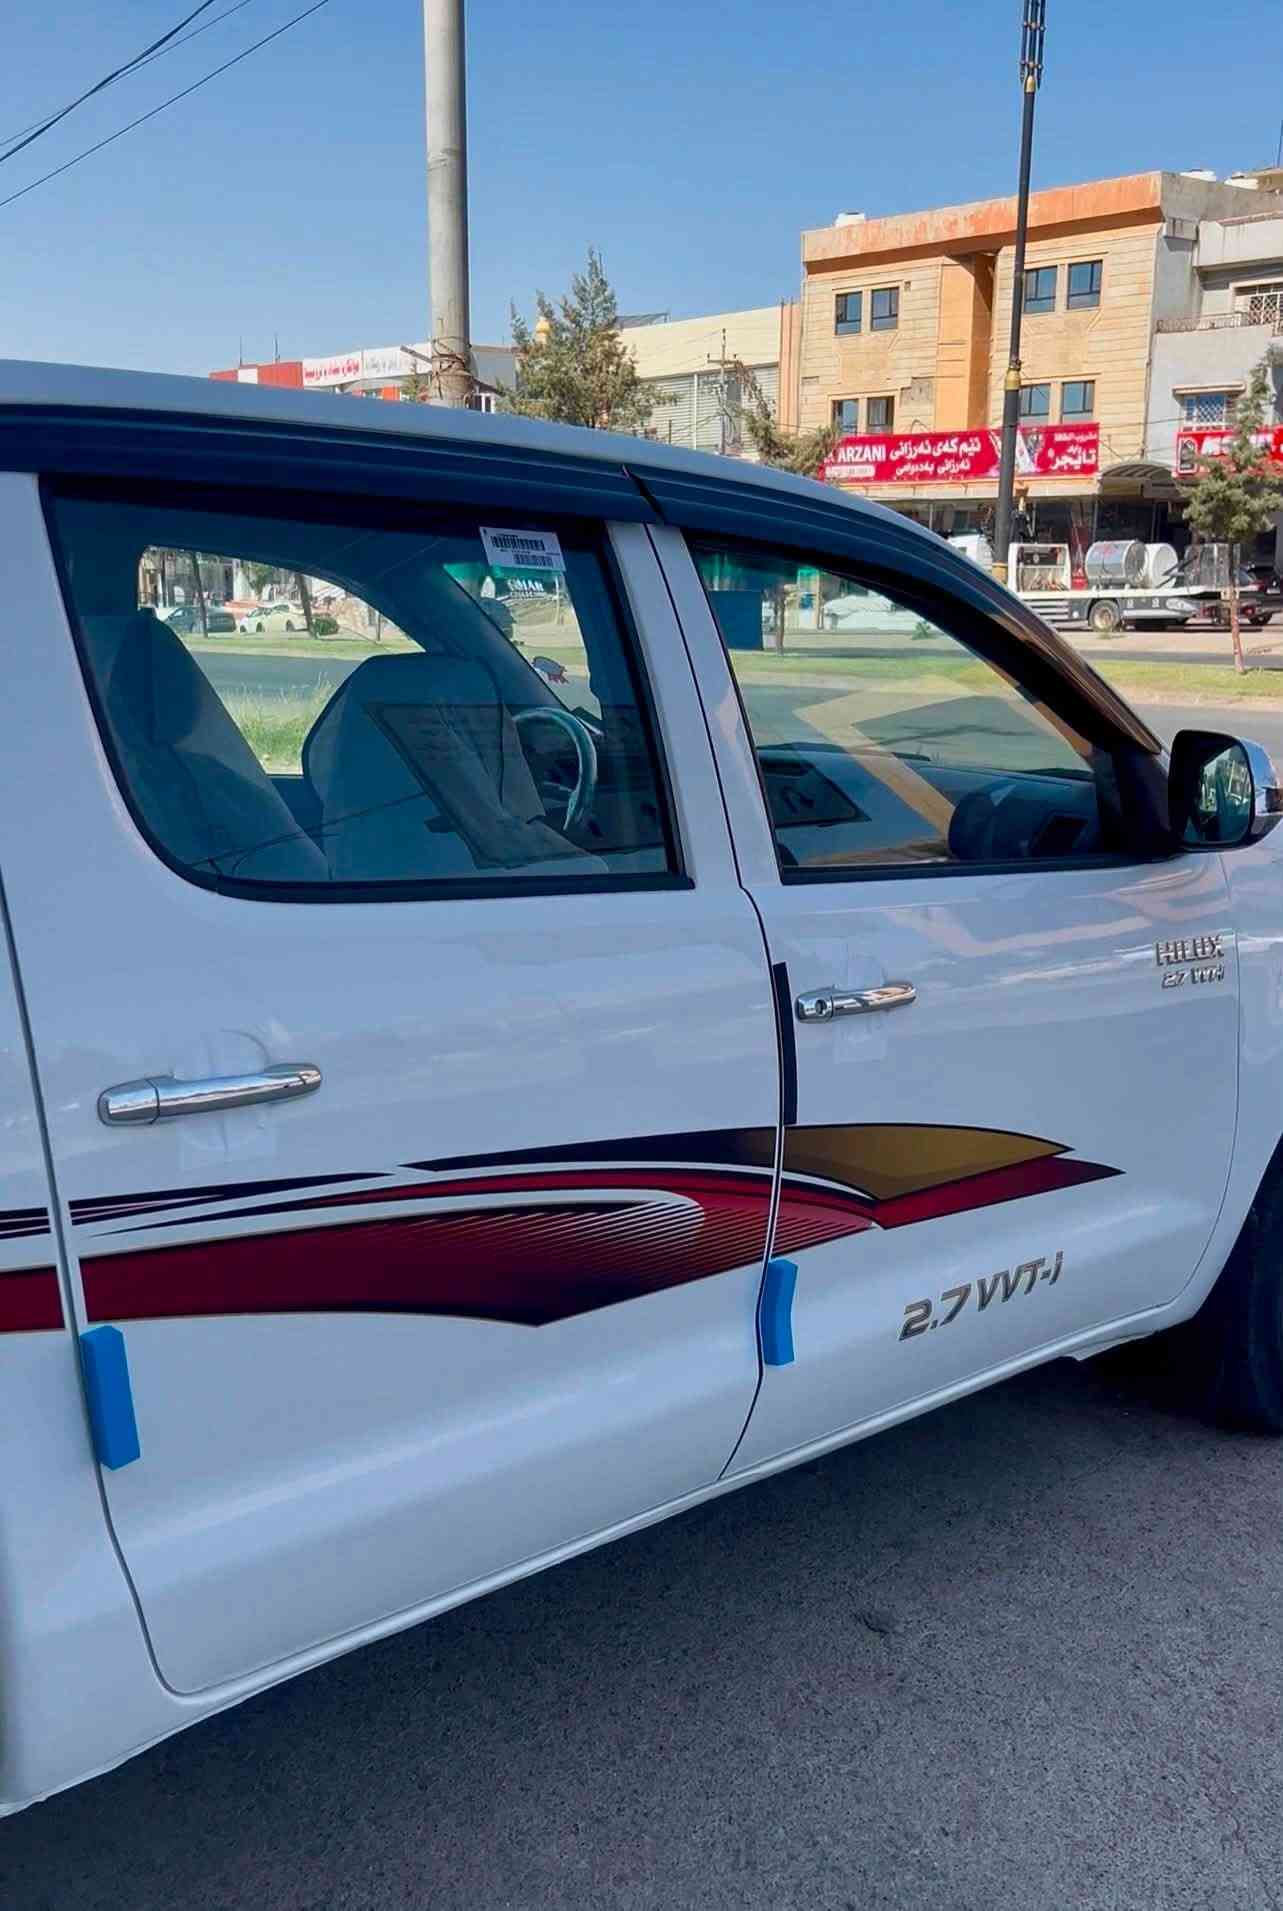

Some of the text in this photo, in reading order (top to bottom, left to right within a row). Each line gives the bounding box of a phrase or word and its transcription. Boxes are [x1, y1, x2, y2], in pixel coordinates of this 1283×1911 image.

[837, 444, 887, 463] ARZANI
[1156, 935, 1225, 967] HILUX
[898, 1283, 972, 1342] 2.7
